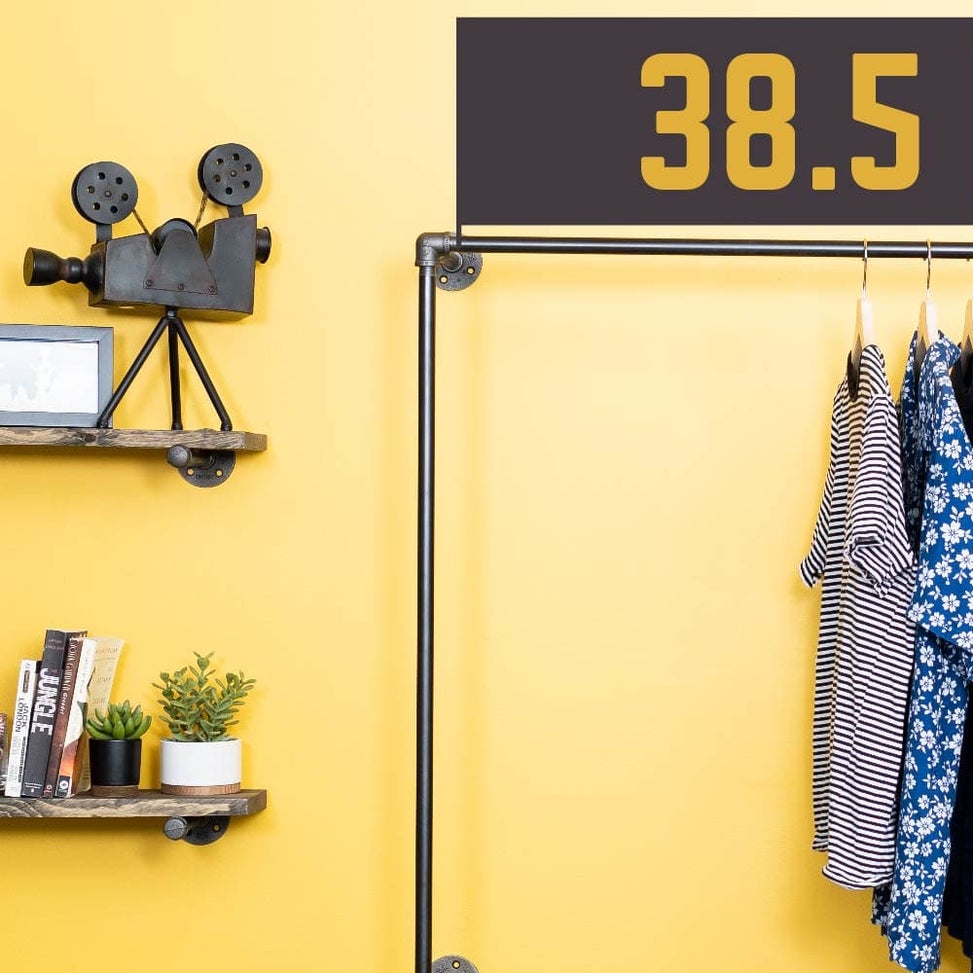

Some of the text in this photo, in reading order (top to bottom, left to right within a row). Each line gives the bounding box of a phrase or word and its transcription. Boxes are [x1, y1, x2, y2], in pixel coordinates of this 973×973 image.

[15, 698, 24, 733] LONDON
[21, 702, 29, 728] JACK
[31, 668, 60, 735] JUNGLE
